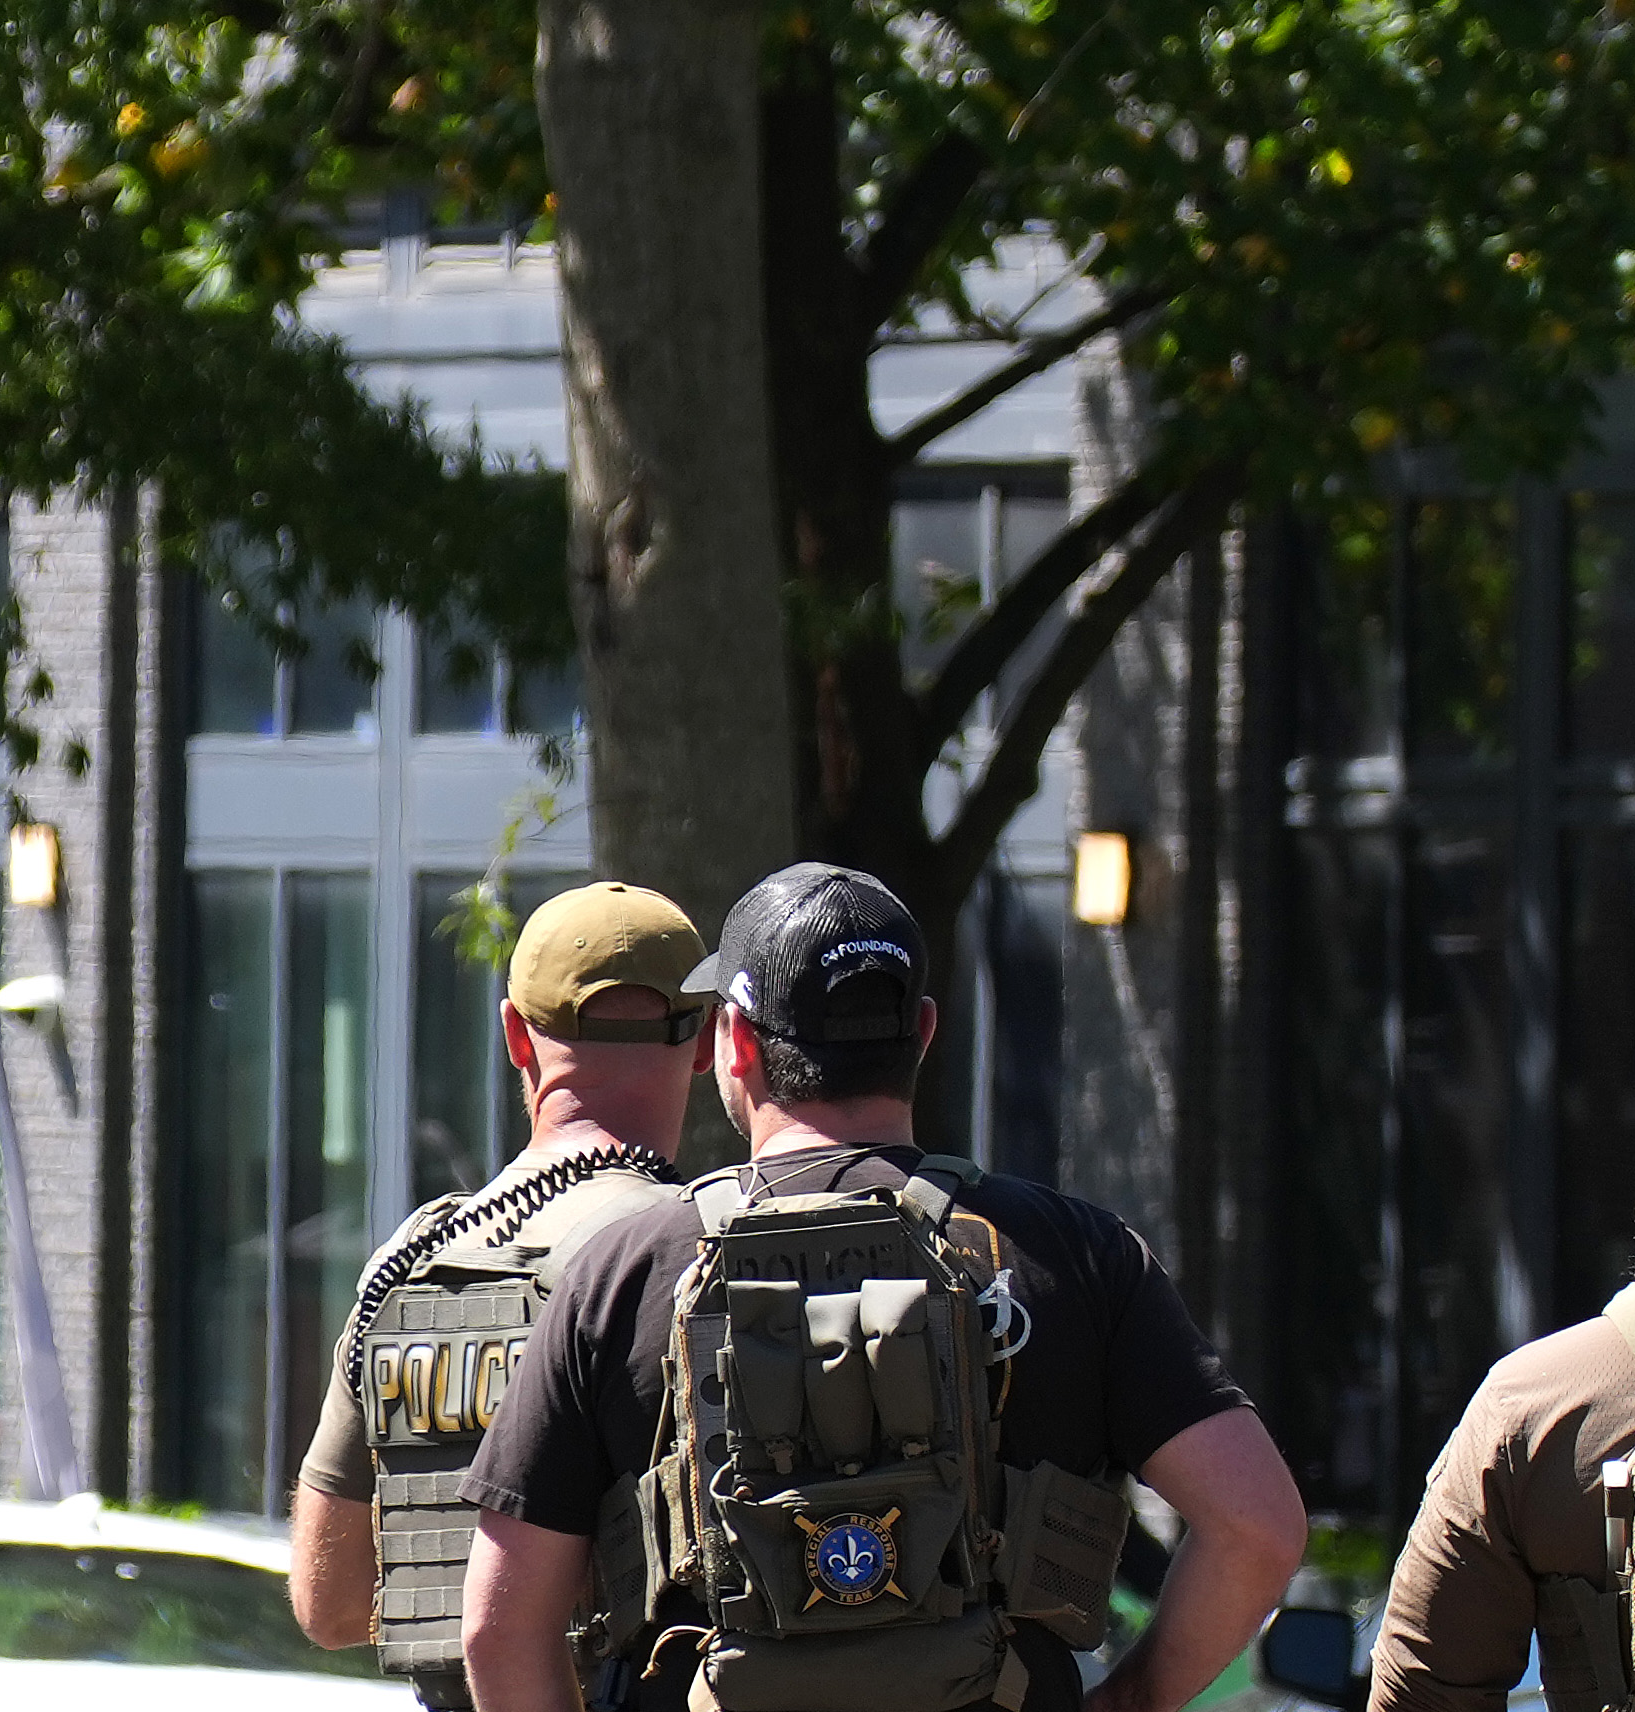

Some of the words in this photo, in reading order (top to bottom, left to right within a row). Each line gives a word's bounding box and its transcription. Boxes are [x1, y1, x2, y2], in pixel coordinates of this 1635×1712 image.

[837, 940, 911, 968] FOUNDATION
[806, 1525, 832, 1578] SPECIAL
[849, 1515, 896, 1570] RESPONSE
[838, 1589, 873, 1603] TEAM
